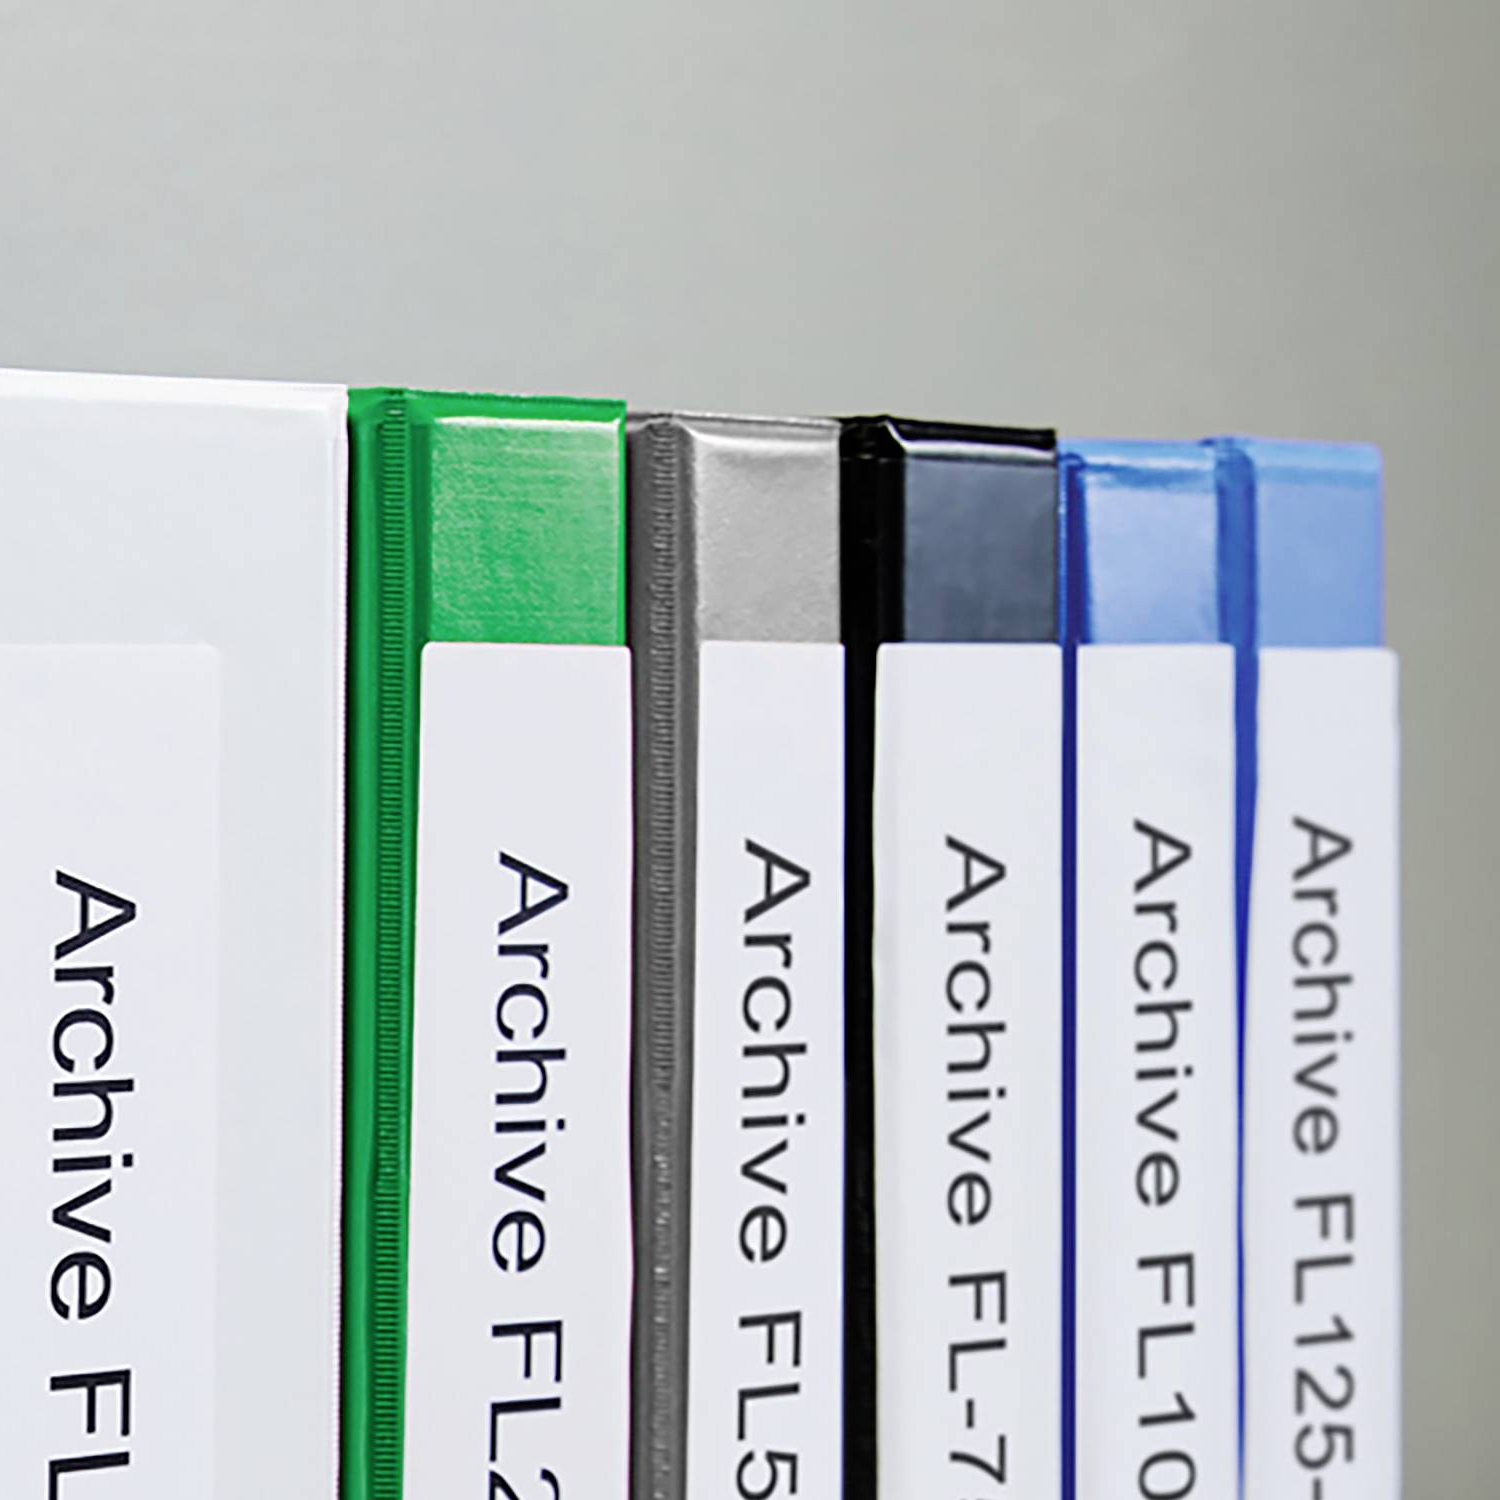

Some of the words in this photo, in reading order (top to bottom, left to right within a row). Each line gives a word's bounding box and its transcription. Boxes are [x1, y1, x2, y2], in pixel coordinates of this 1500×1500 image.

[49, 868, 138, 1321] Archive
[490, 850, 570, 1274] Archive
[738, 837, 812, 1264] Archive
[944, 834, 1008, 1227] Archive
[1133, 818, 1195, 1207] Archive
[1291, 816, 1354, 1155] Archive
